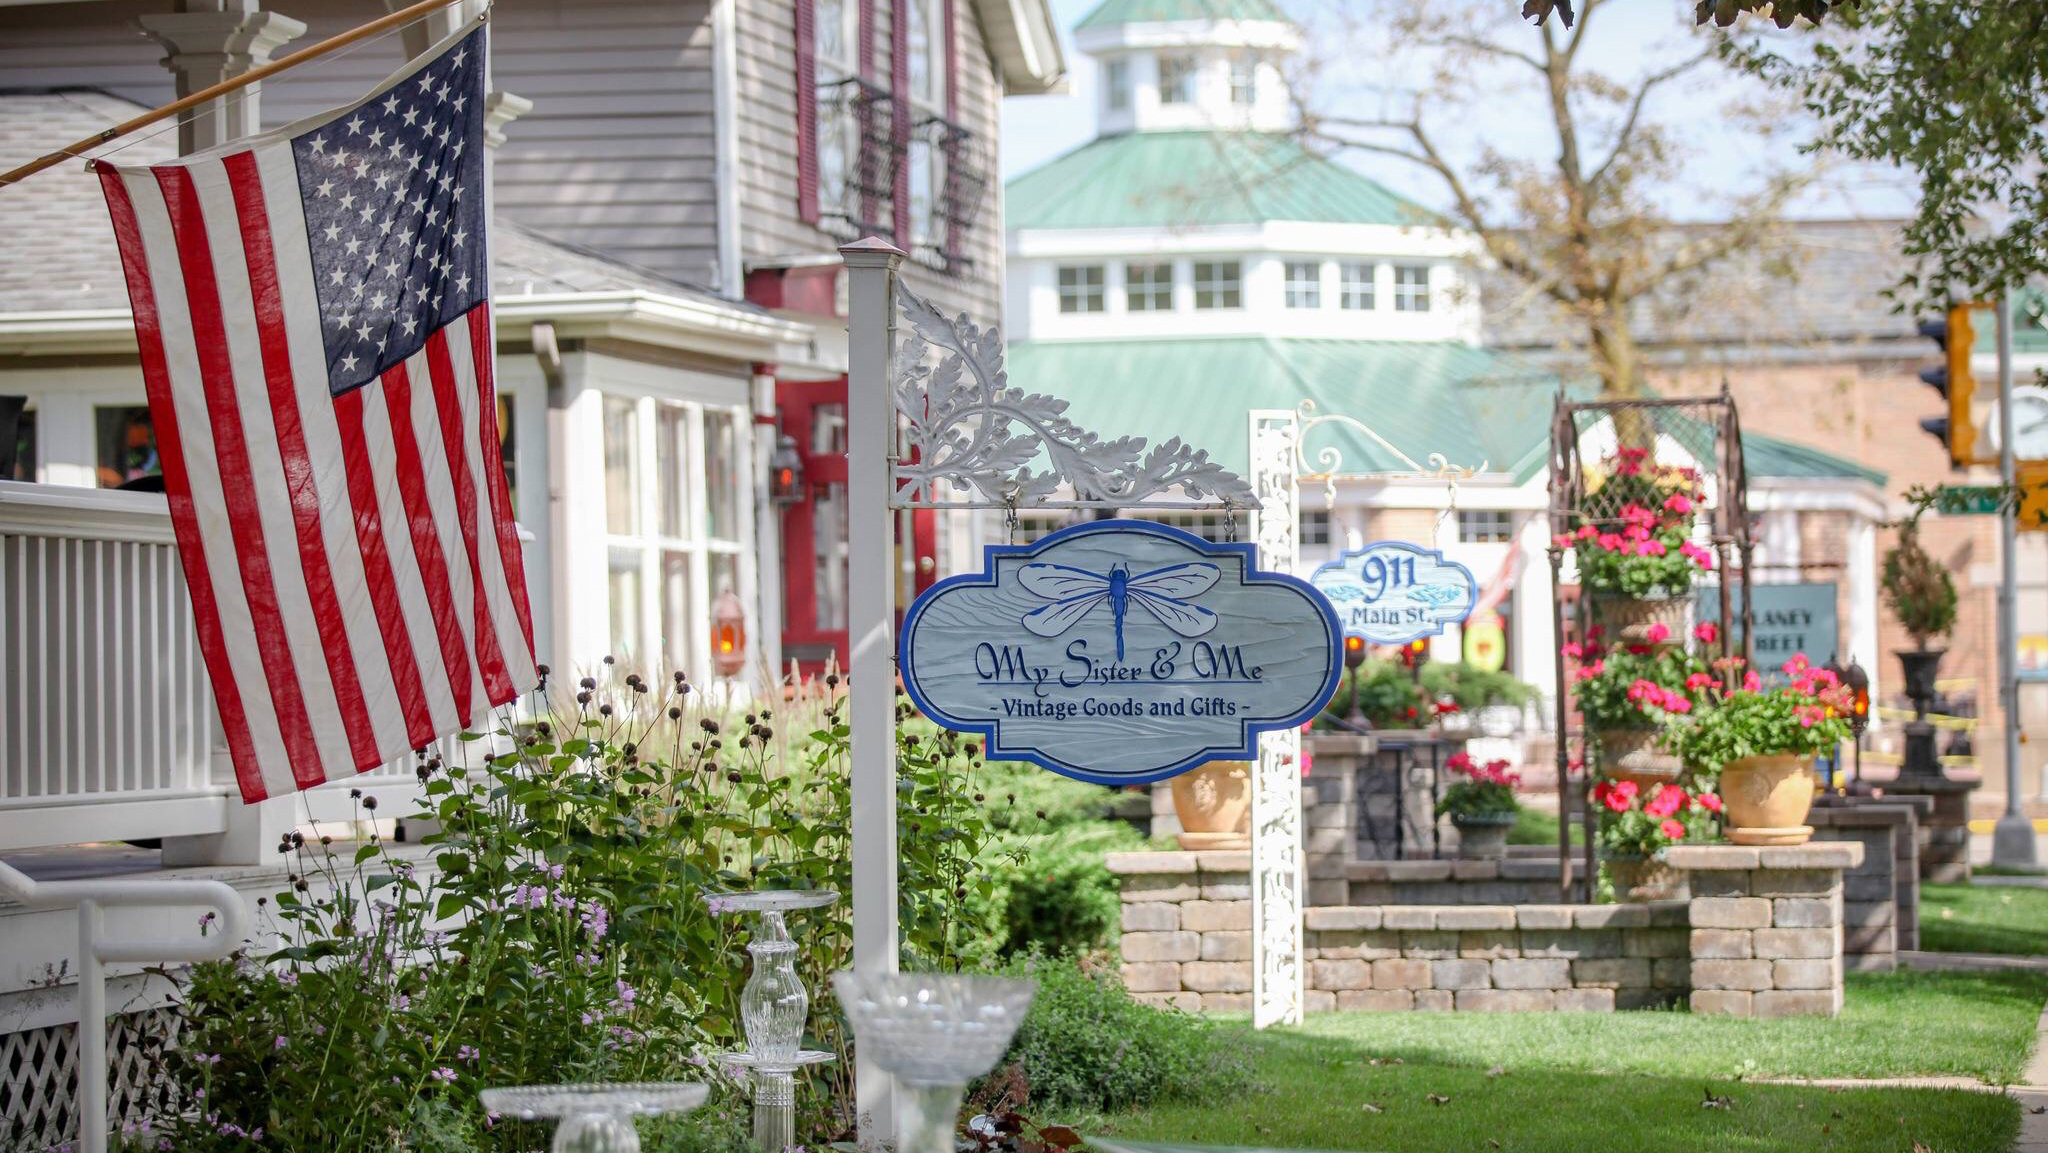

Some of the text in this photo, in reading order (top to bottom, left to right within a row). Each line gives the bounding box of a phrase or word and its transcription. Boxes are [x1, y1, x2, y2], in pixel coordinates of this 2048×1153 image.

[1362, 556, 1416, 604] 911
[1351, 606, 1432, 625] Main St.
[975, 639, 1264, 697] My Sister & Me
[1001, 698, 1077, 721] Vintage
[1083, 697, 1143, 716] Goods
[1149, 697, 1186, 716] and
[1190, 697, 1236, 716] Gifts
